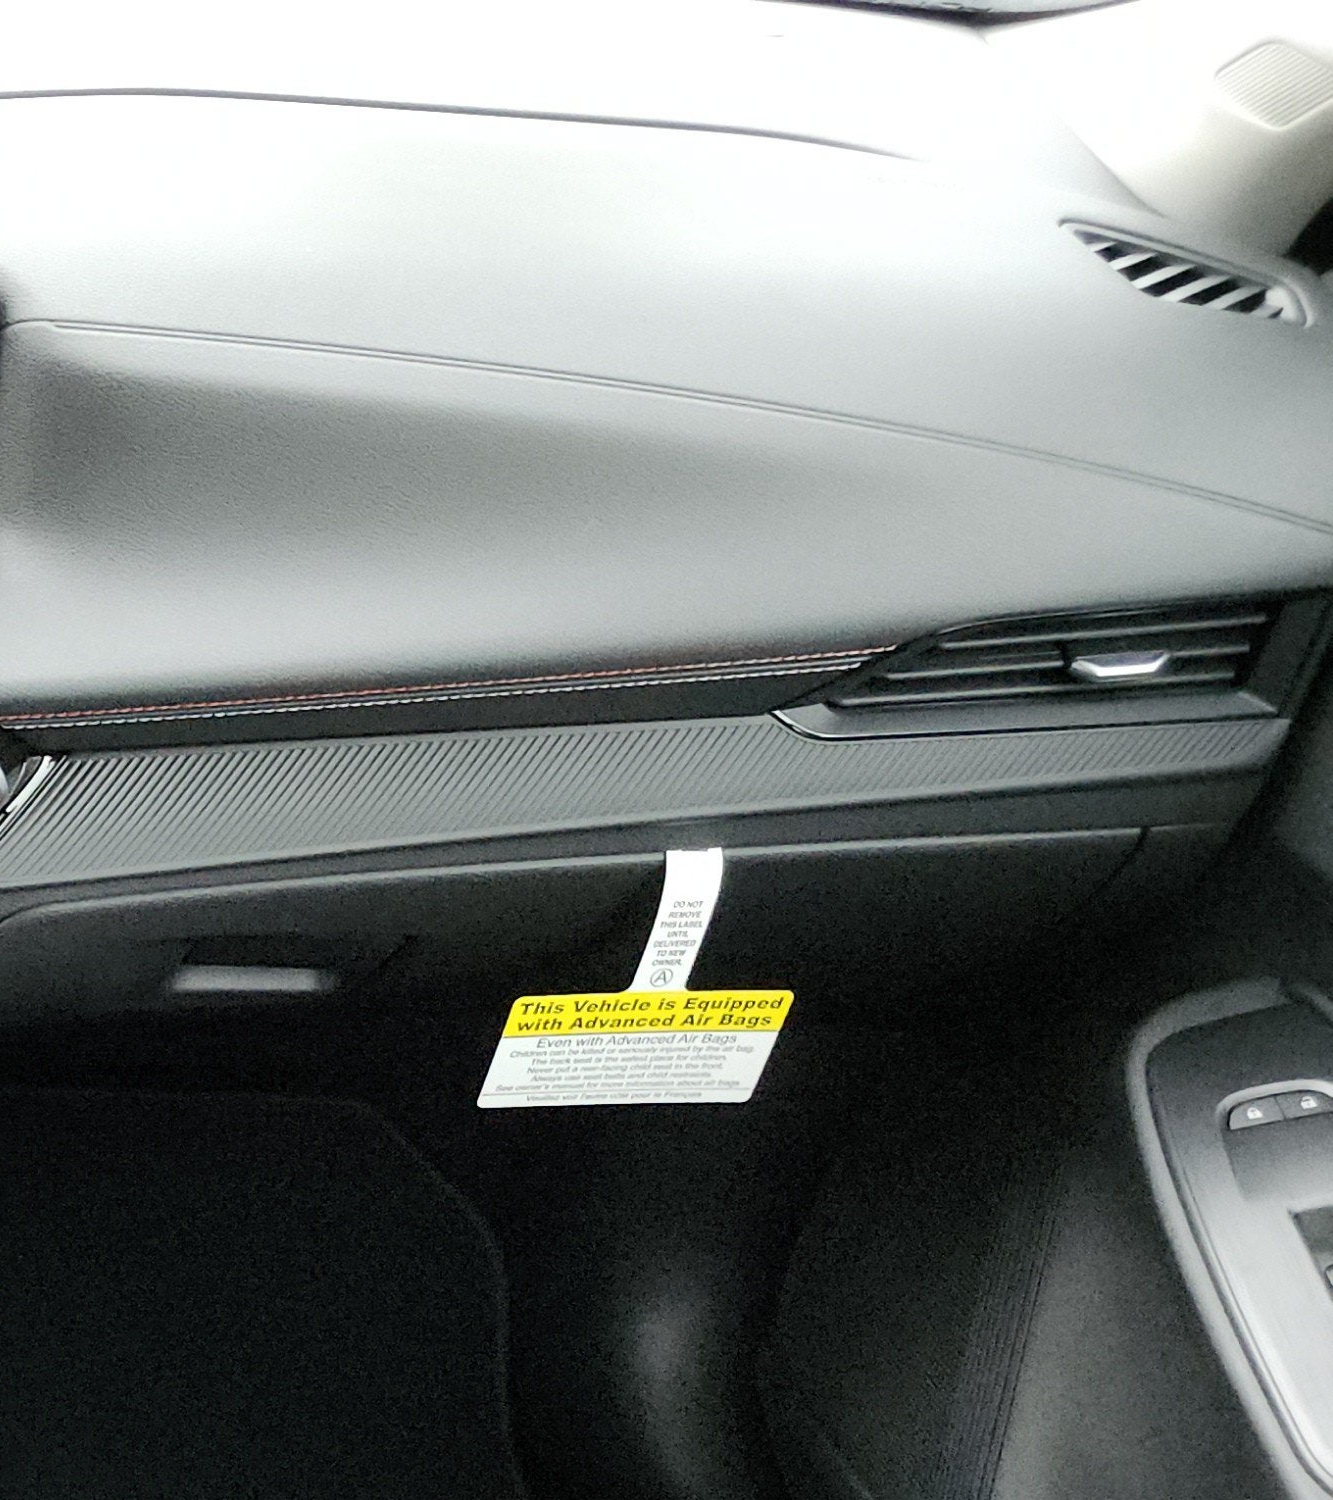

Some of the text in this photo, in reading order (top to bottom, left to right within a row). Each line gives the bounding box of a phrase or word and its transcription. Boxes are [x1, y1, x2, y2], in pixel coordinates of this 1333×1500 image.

[678, 920, 703, 928] LABEL
[521, 997, 784, 1016] This Vehicle is Equipped
[518, 1013, 772, 1032] with Advanced Air Bags
[537, 1033, 737, 1048] Even with Advanced Air Bags
